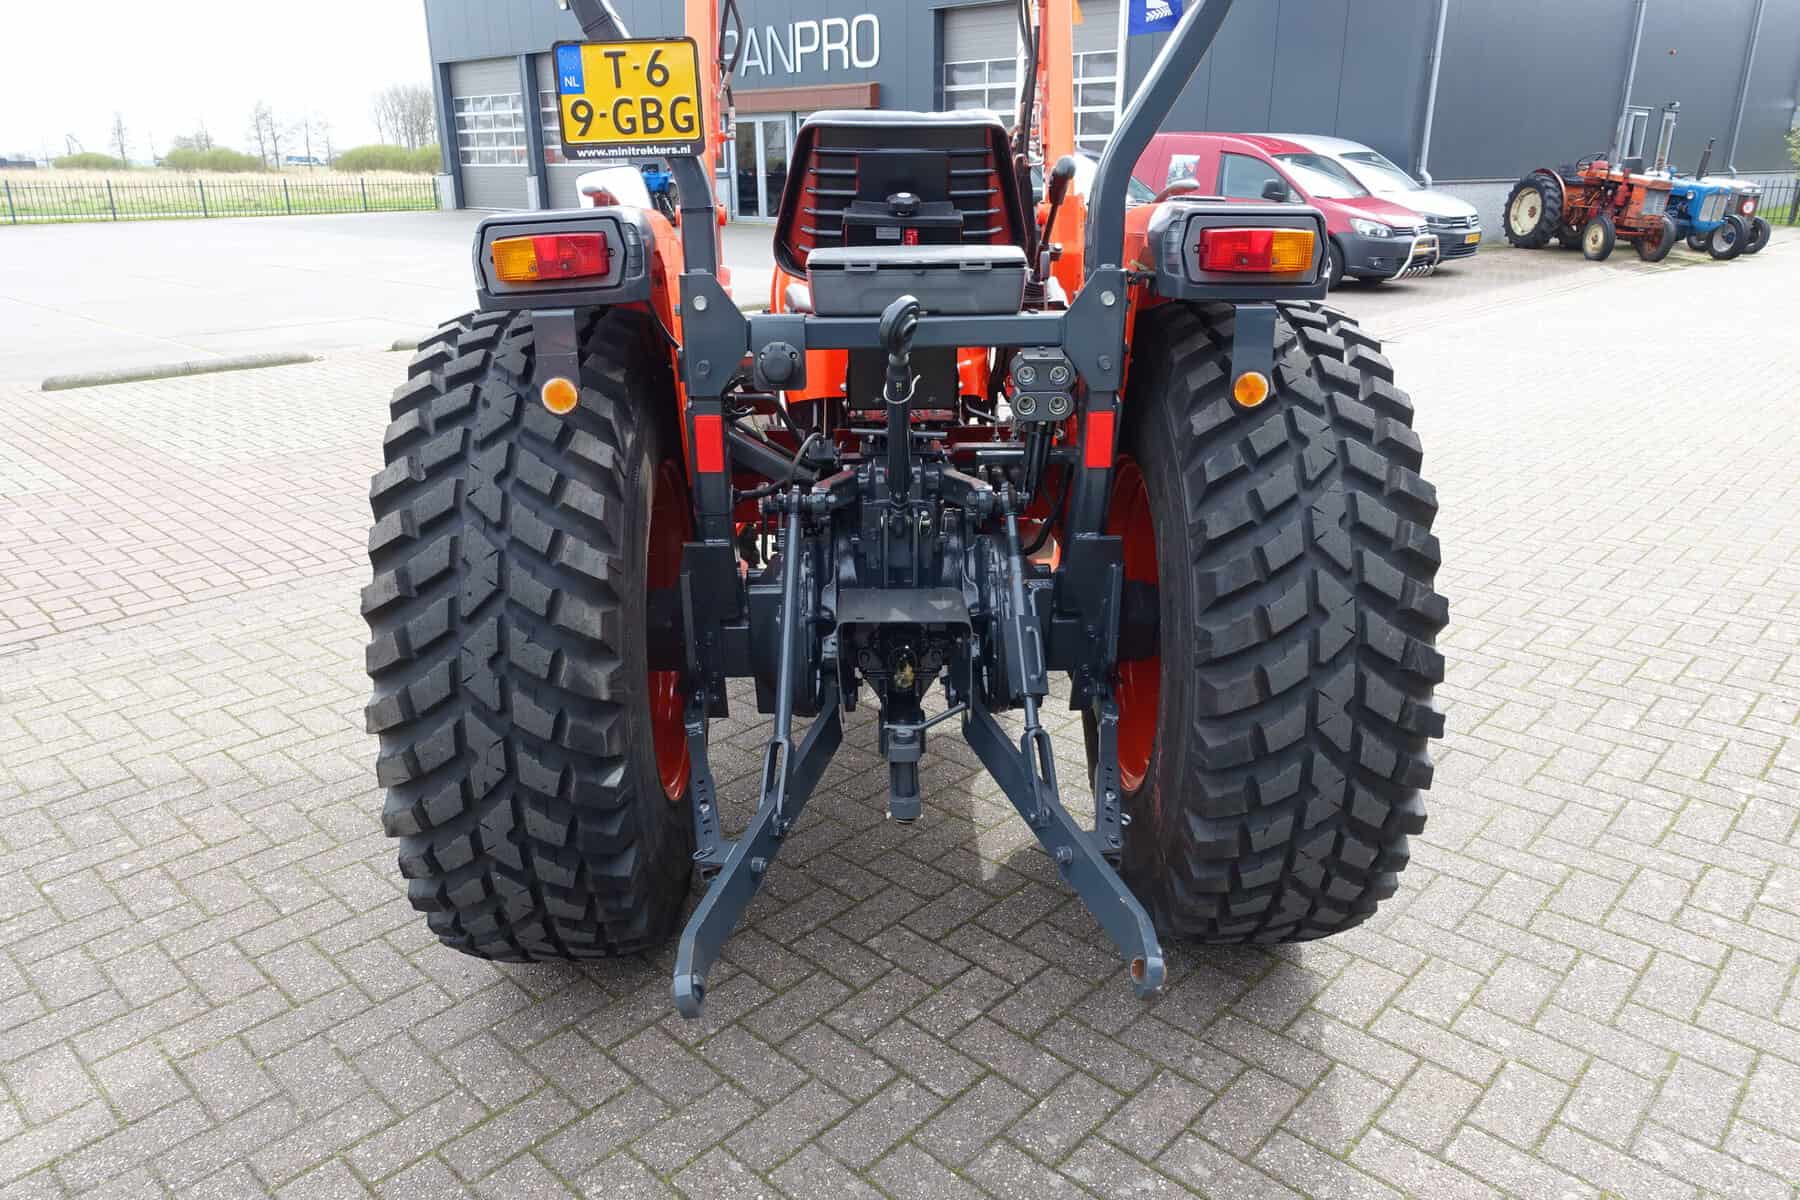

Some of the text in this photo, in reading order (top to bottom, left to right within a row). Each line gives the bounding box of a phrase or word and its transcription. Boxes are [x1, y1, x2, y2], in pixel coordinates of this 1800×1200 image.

[564, 76, 580, 88] NL
[603, 49, 670, 89] T-6
[570, 96, 694, 137] 9-GBG
[576, 144, 692, 158] www.minitrekkers.nl
